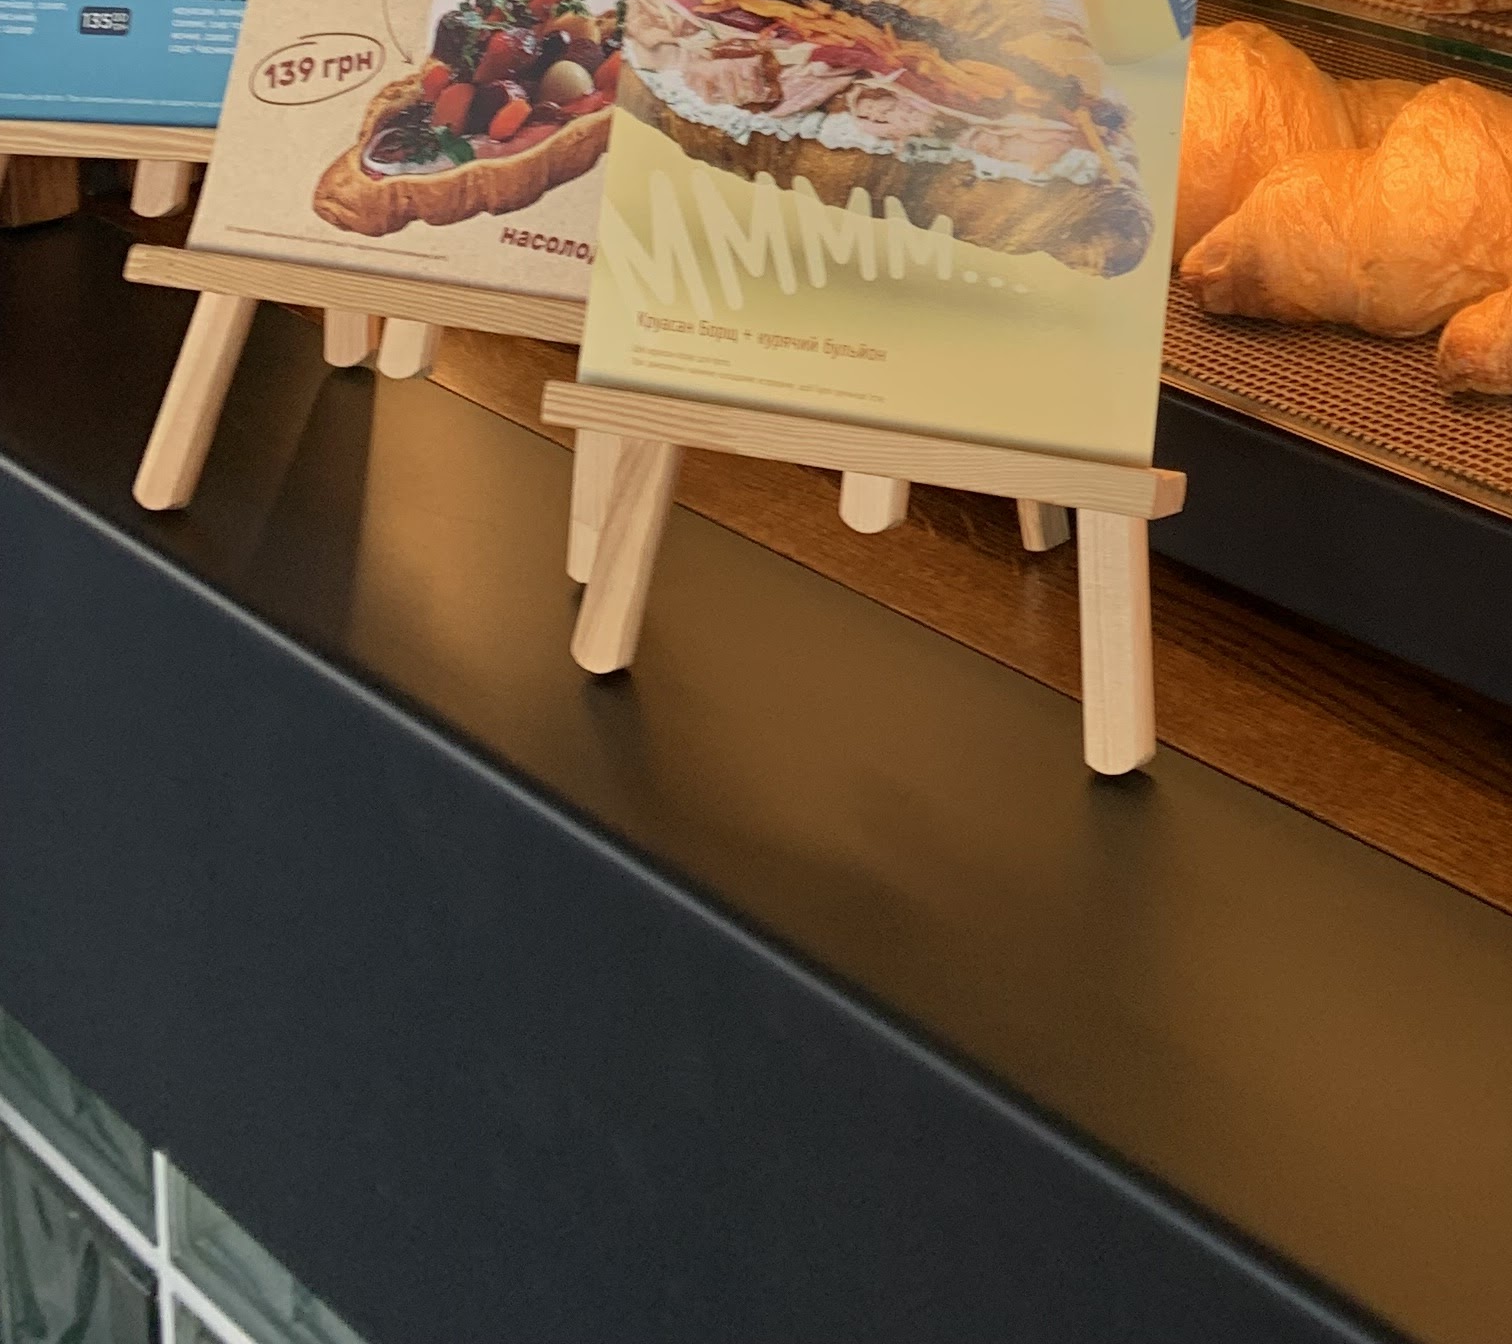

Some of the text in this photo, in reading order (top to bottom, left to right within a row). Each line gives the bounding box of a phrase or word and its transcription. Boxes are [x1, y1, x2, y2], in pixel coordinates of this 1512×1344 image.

[264, 51, 374, 88] 139 грн
[636, 311, 695, 333] Круасан
